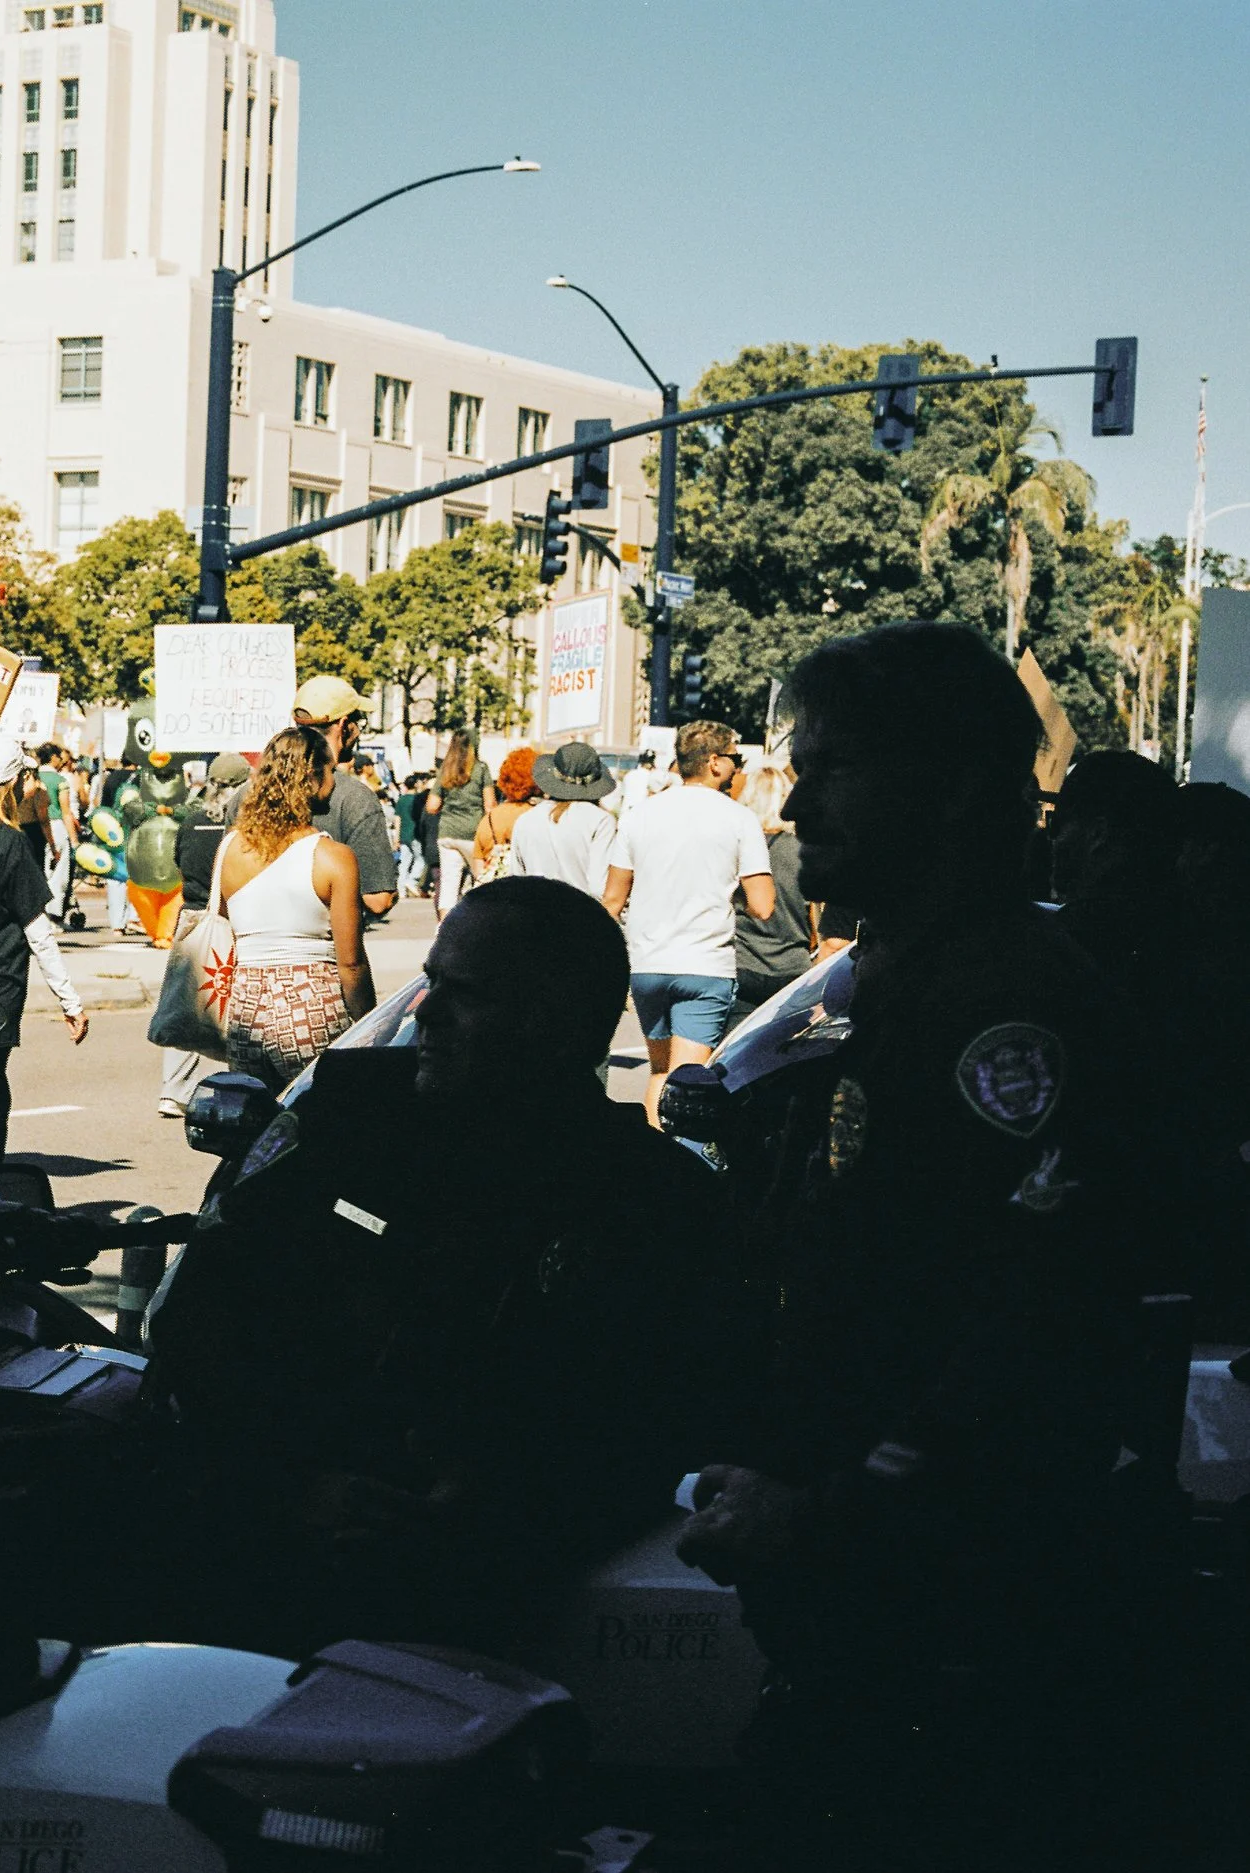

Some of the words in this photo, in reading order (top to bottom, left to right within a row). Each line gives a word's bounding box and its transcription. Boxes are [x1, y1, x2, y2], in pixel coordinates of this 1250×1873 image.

[166, 632, 213, 657] DEAR
[550, 668, 597, 697] RACIST
[190, 687, 276, 710] REQUIRED
[163, 712, 191, 735] DO
[596, 1615, 721, 1661] POLICE
[21, 1819, 84, 1840] DIEGO
